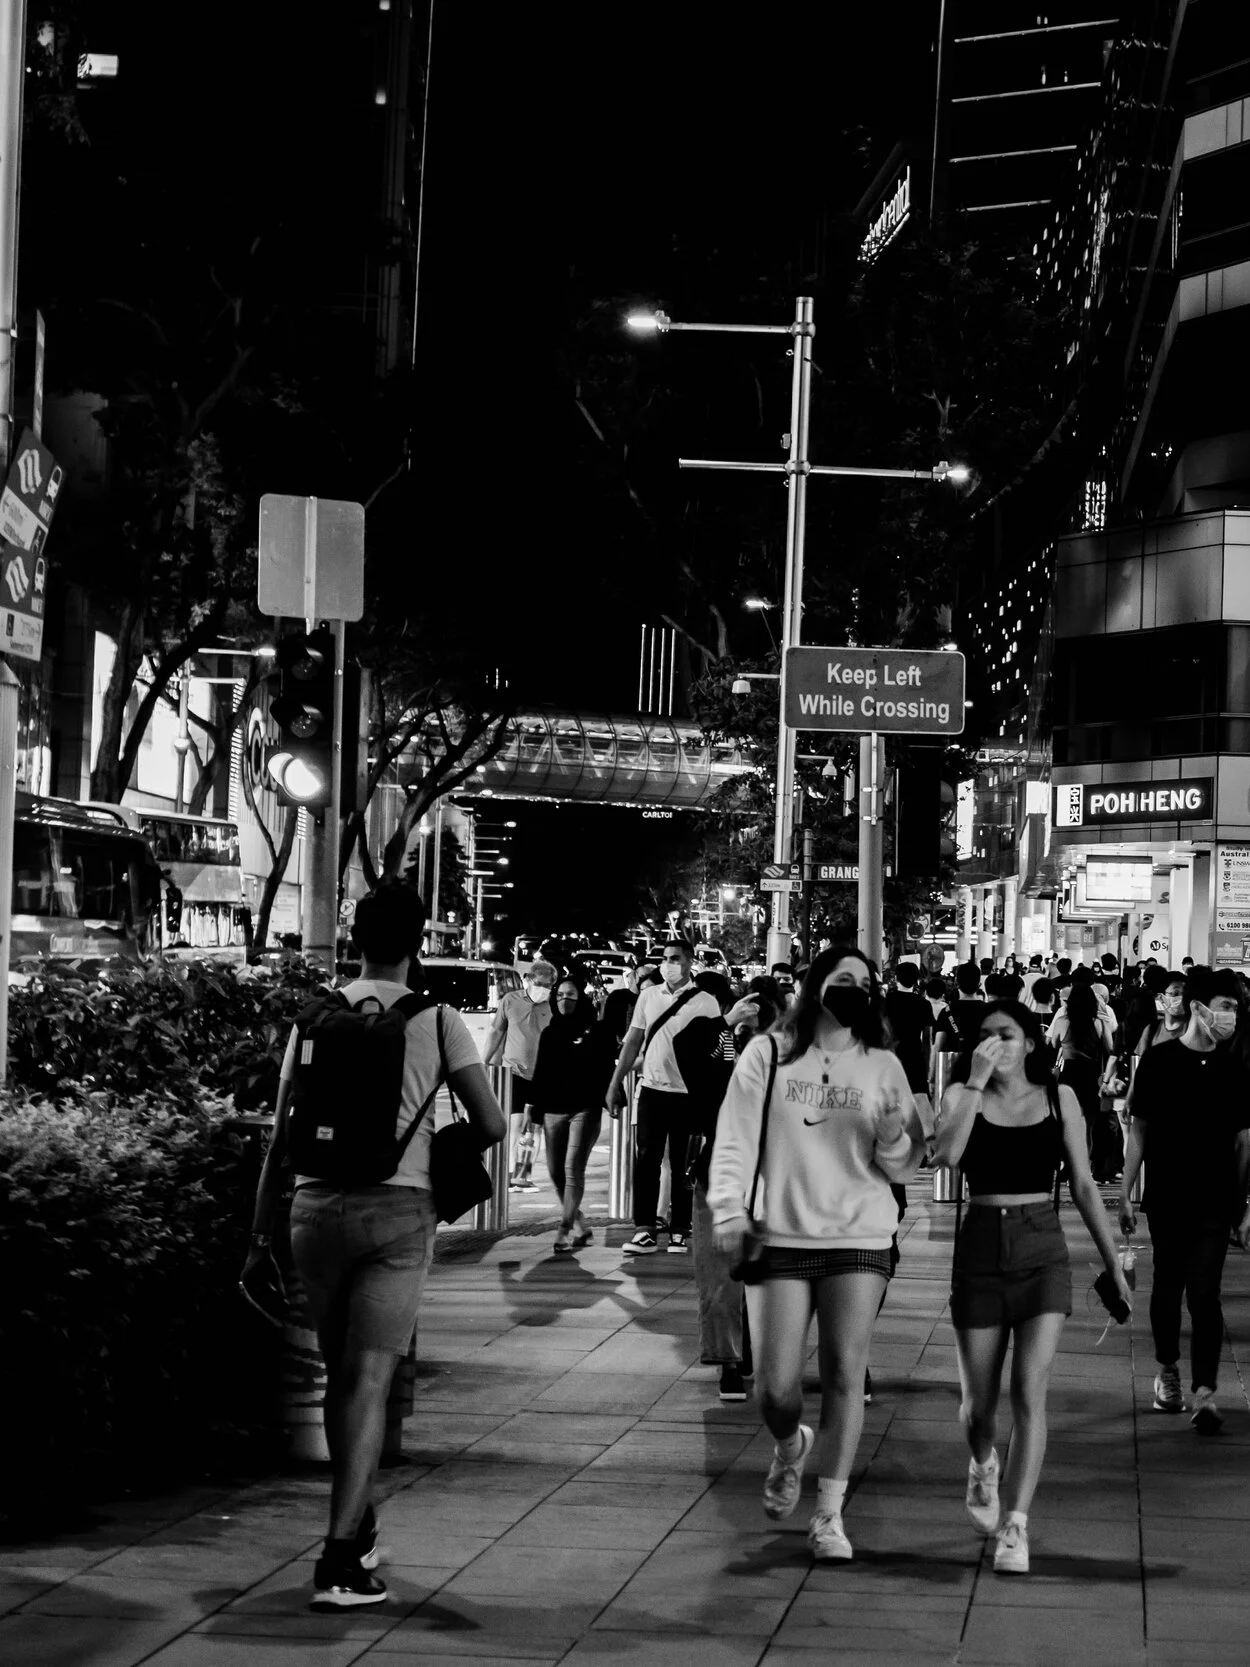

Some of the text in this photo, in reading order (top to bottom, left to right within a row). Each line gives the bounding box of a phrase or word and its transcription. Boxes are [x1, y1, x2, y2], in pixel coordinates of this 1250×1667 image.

[827, 662, 922, 690] Keep Left
[799, 693, 950, 724] While Crossing
[1069, 787, 1081, 823] 宝兴
[1090, 788, 1202, 815] POH HENG
[820, 866, 860, 879] GRANG
[785, 1080, 863, 1111] NIKE
